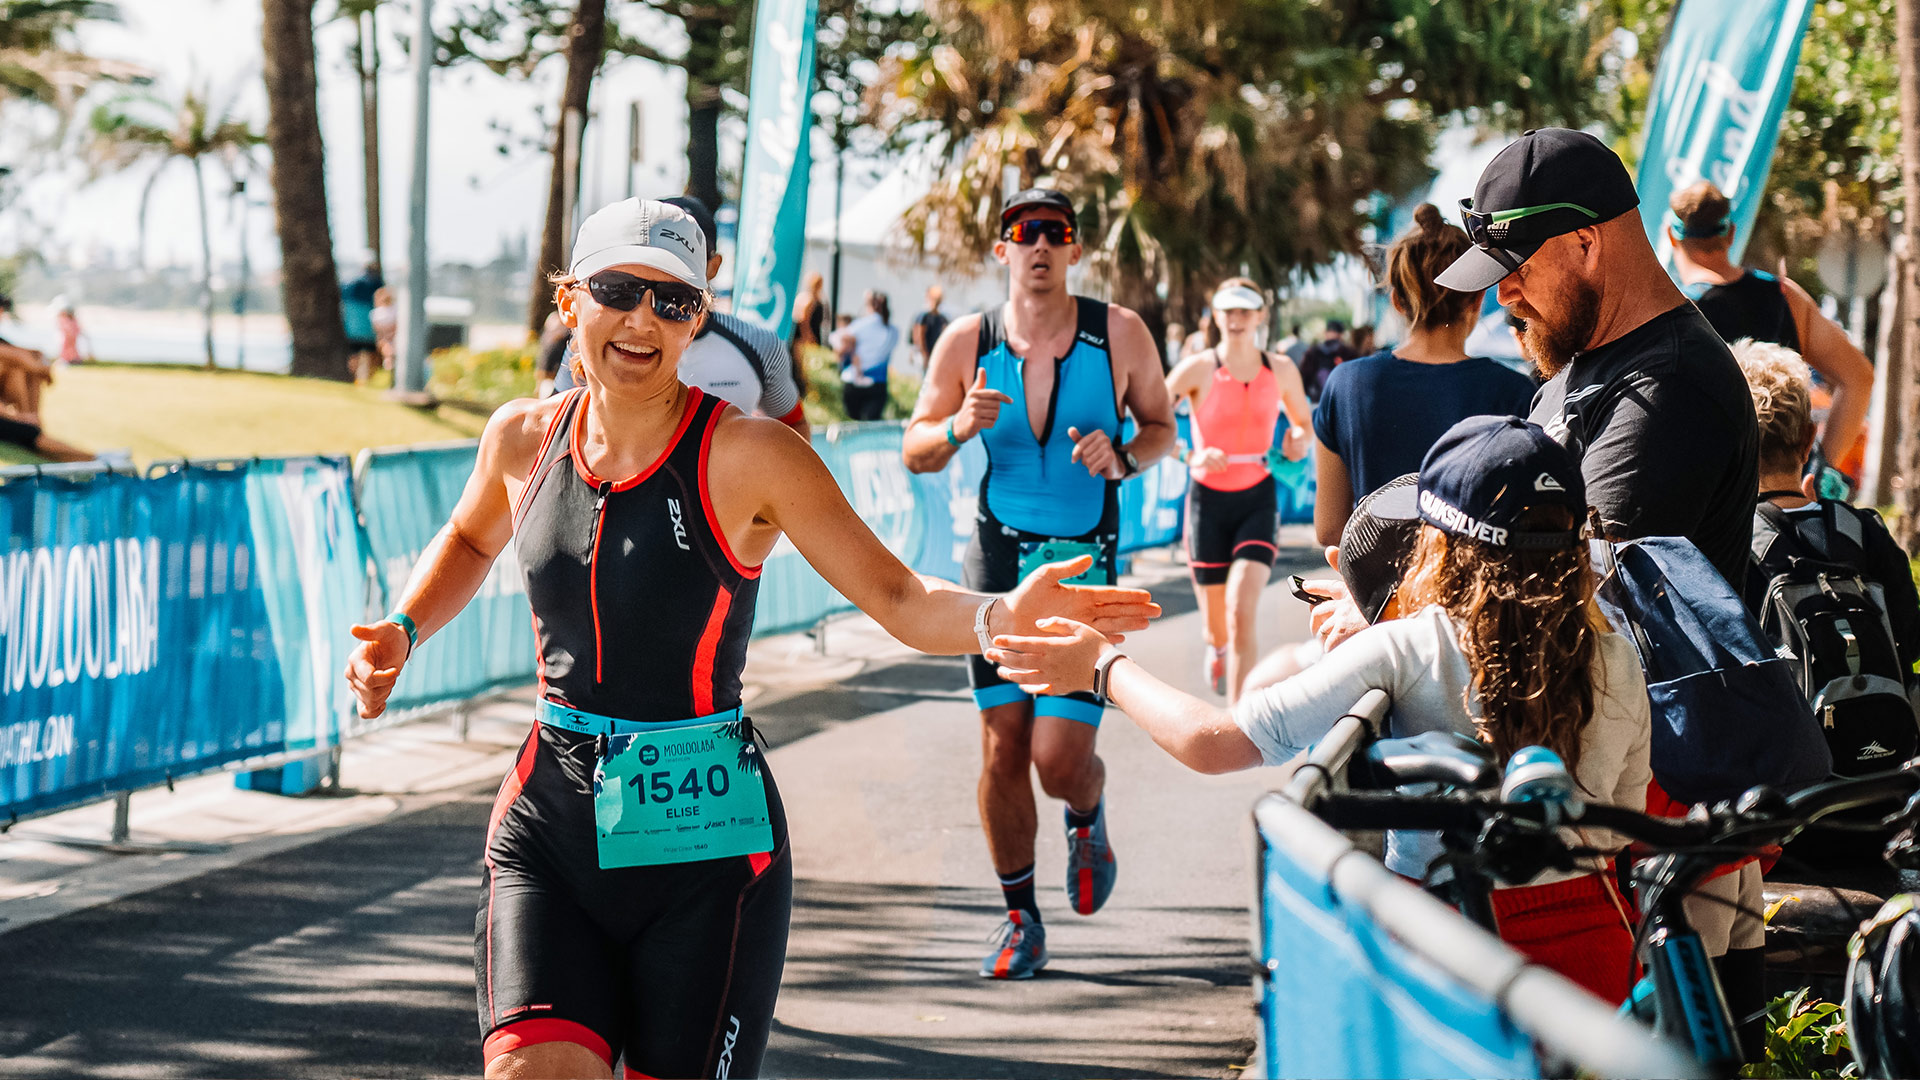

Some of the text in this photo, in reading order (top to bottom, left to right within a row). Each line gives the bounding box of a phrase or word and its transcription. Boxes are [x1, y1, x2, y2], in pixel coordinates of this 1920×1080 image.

[659, 228, 695, 254] 2XU
[667, 497, 690, 551] 2XU
[1420, 489, 1509, 546] QUIKSILVER
[663, 738, 715, 757] MOOLOOLABA
[628, 764, 730, 805] 1540
[666, 805, 700, 819] ELISE
[715, 1014, 740, 1080] 2XU
